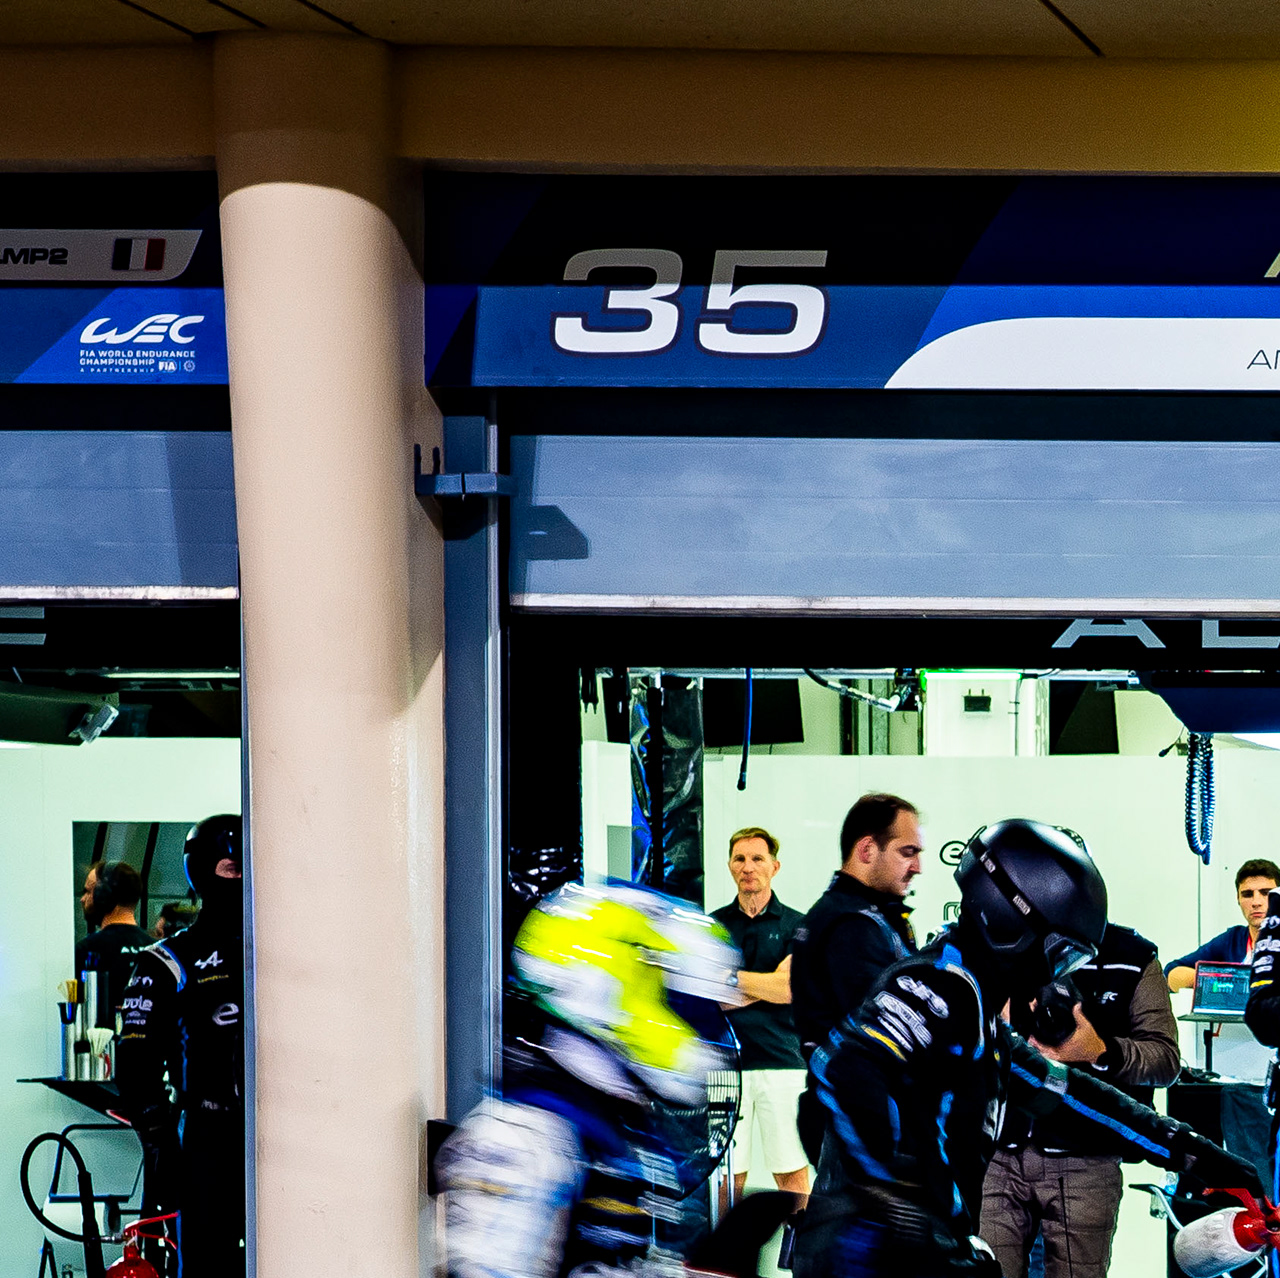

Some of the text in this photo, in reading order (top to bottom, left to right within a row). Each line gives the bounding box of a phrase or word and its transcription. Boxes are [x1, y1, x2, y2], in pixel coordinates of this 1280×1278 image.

[0, 247, 69, 265] MP2
[552, 247, 830, 355] 35
[80, 314, 204, 344] WEC
[80, 350, 196, 358] FIA WORLD ENDURANCE
[80, 358, 155, 366] CHAMPIONSHIP
